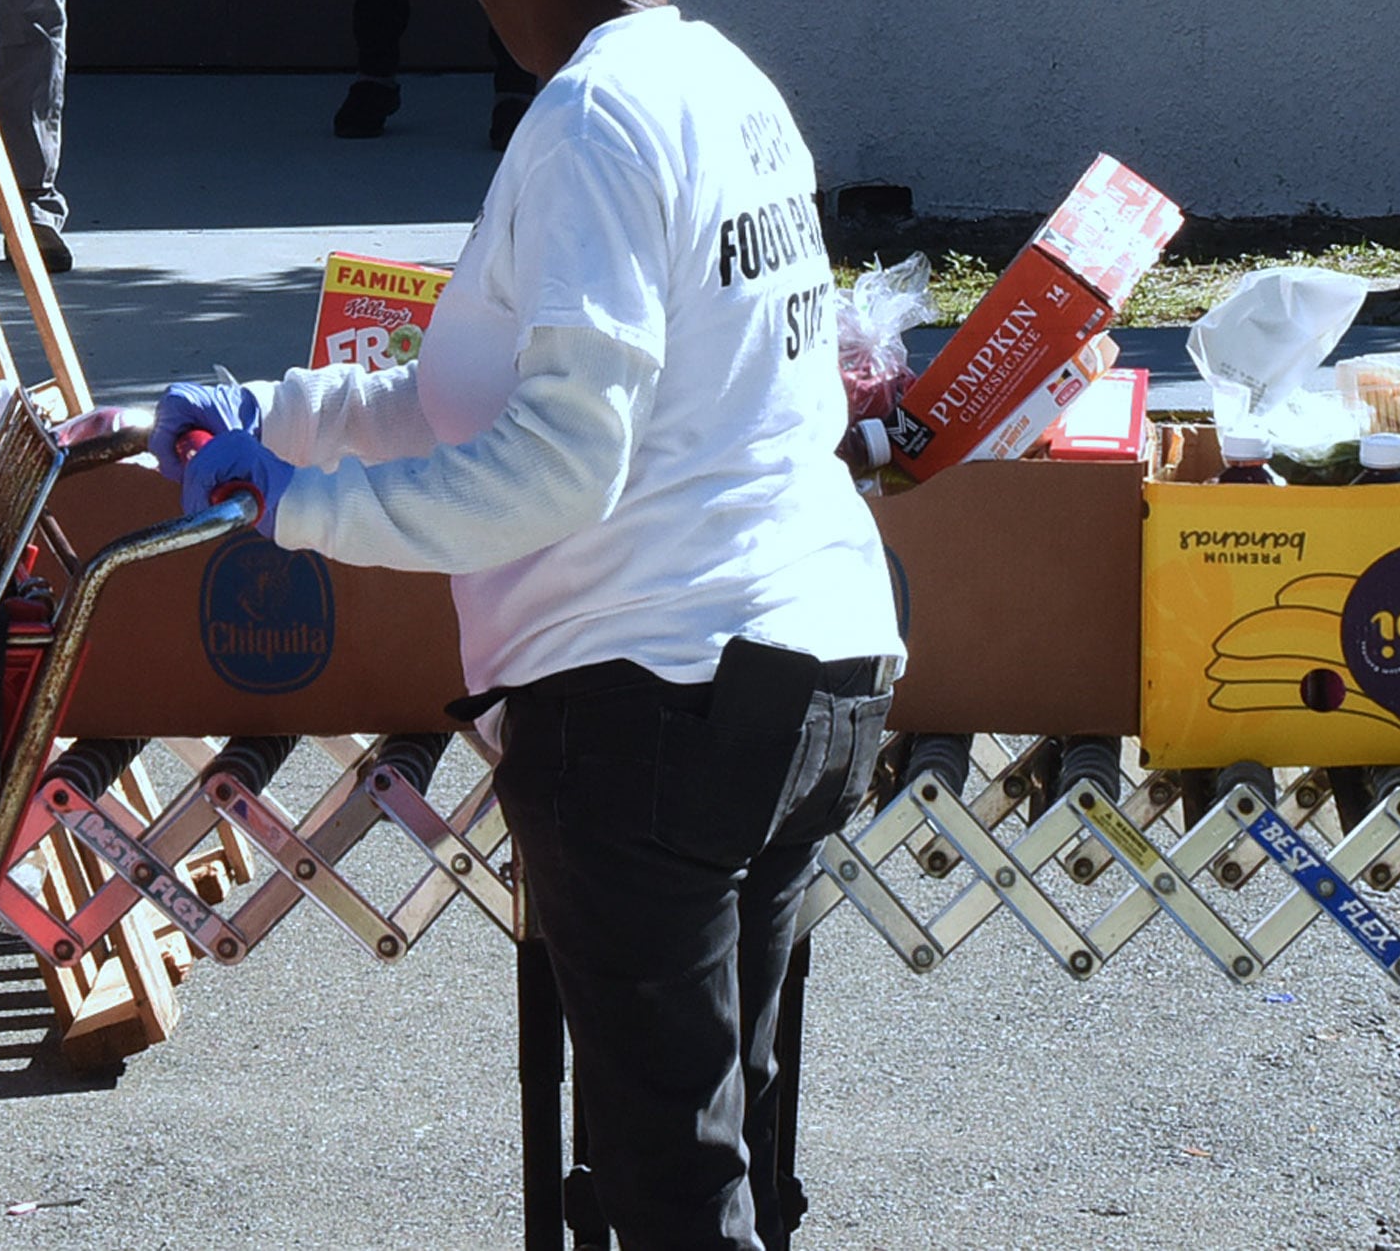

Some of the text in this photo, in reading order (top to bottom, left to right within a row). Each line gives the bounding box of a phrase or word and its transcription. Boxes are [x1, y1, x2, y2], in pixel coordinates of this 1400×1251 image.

[719, 202, 797, 287] FOOD
[337, 266, 426, 296] FAMILY
[1045, 283, 1066, 304] 14
[344, 296, 412, 327] Kellogg's
[326, 323, 425, 374] FRO
[928, 299, 1038, 427] PUMPKIN
[958, 328, 1042, 425] CHEESECAKE
[1179, 530, 1306, 561] bananas
[1203, 552, 1282, 565] PREMIUM
[208, 621, 328, 664] Chiquita
[1258, 817, 1400, 950] BEST FLEX
